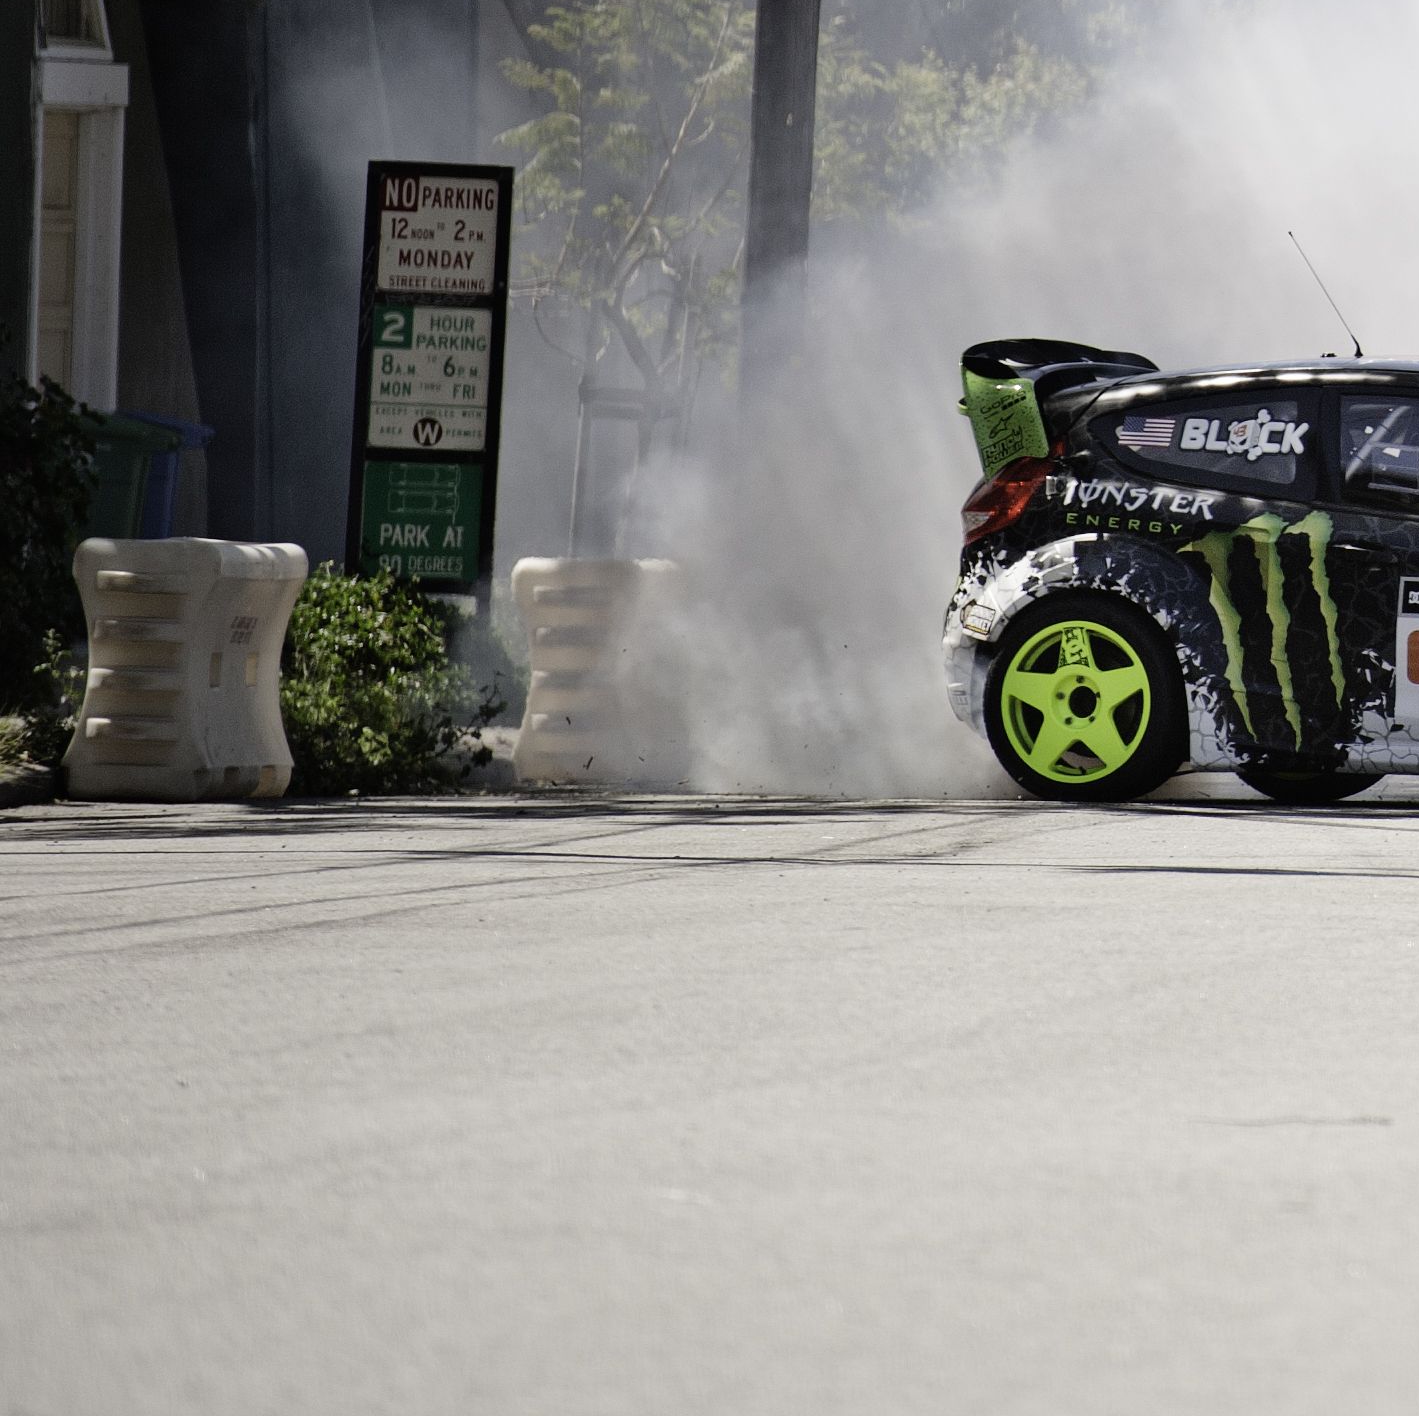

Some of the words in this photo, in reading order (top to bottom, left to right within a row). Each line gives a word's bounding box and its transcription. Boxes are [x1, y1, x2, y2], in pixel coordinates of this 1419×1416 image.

[385, 178, 416, 208] NO
[422, 186, 494, 211] PARKING
[391, 217, 409, 239] 12
[411, 228, 435, 240] NOON
[454, 220, 466, 241] 2
[398, 249, 474, 270] MONDAY
[389, 275, 428, 288] STREET
[430, 276, 485, 292] CLEANING
[381, 312, 405, 343] 2
[430, 315, 475, 333] HOUR
[416, 335, 486, 351] PARKING
[381, 354, 394, 375] 8
[443, 355, 455, 377] 6
[379, 381, 412, 397] MON
[453, 384, 475, 400] FRI
[416, 421, 440, 445] W
[1066, 512, 1184, 534] ENERGY
[380, 523, 431, 548] PARK
[442, 525, 465, 548] AT
[408, 555, 464, 572] DEGREES
